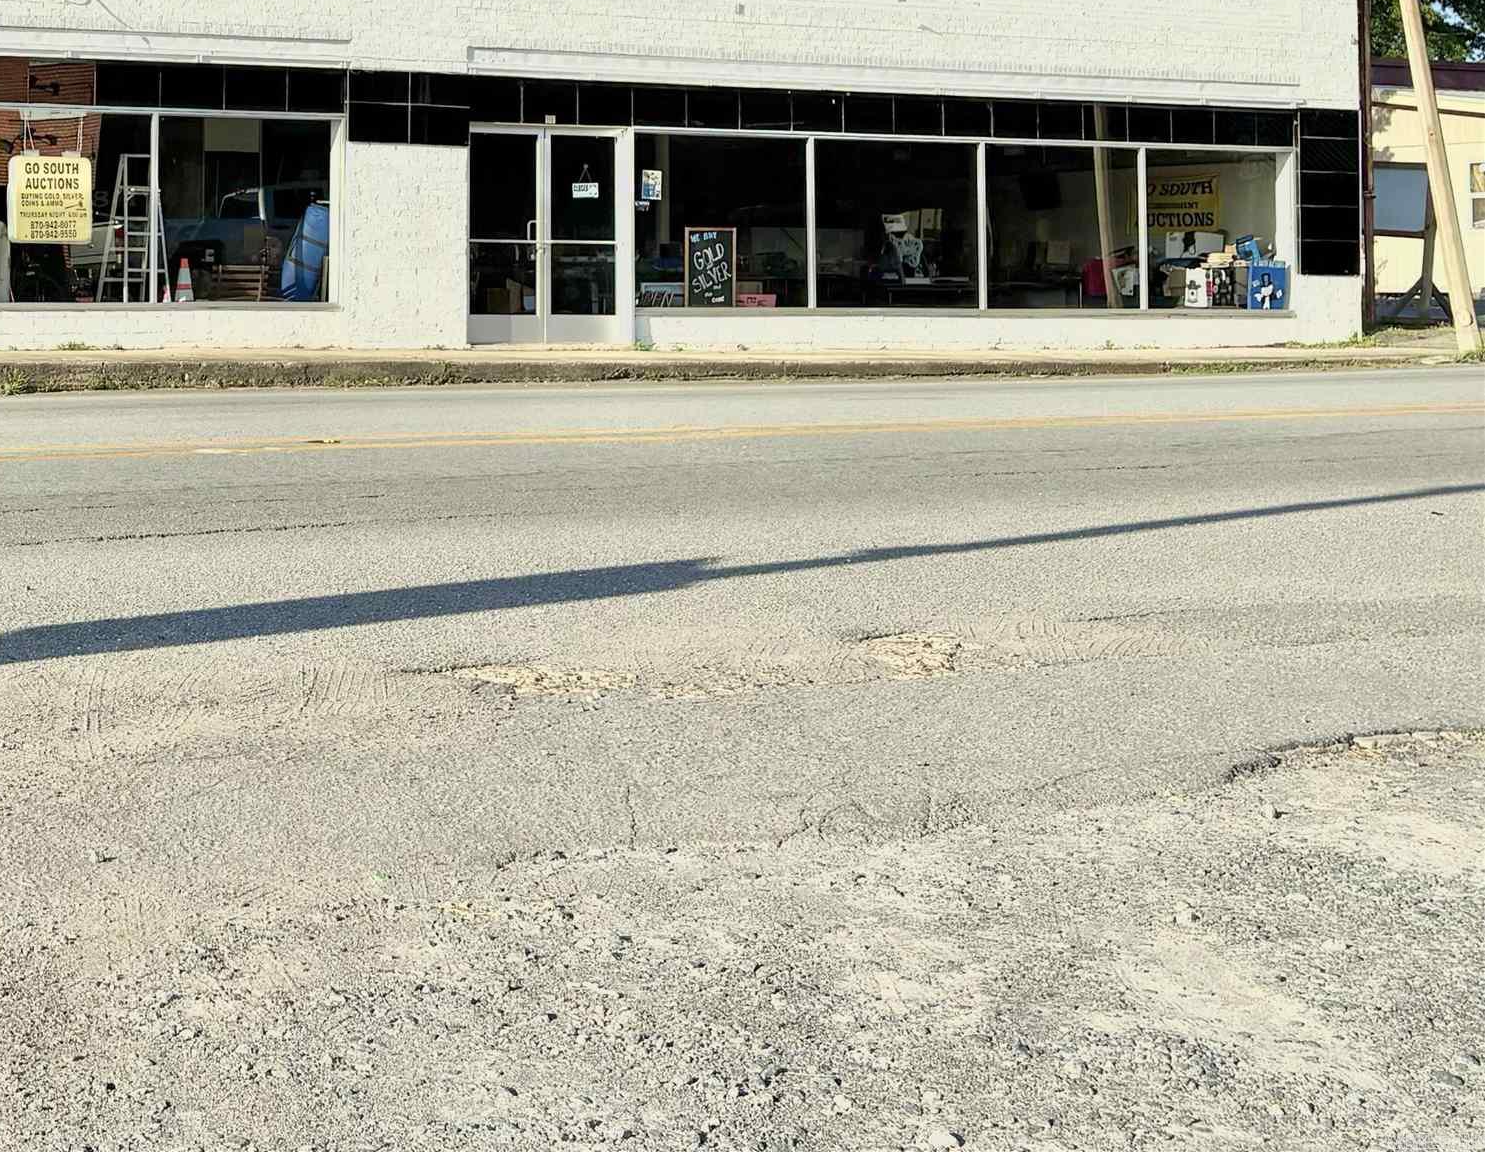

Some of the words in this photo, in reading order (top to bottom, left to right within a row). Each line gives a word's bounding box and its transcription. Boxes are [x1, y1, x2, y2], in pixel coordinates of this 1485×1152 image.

[24, 162, 40, 175] GO
[43, 162, 80, 175] SOUTH
[24, 177, 80, 190] AUCTIONS
[1159, 181, 1213, 196] SOUTH
[21, 199, 39, 207] COINS
[46, 199, 64, 207] AMMO
[1147, 211, 1214, 228] UCTIONS
[693, 242, 725, 271] GOLD
[691, 261, 732, 294] SILVER
